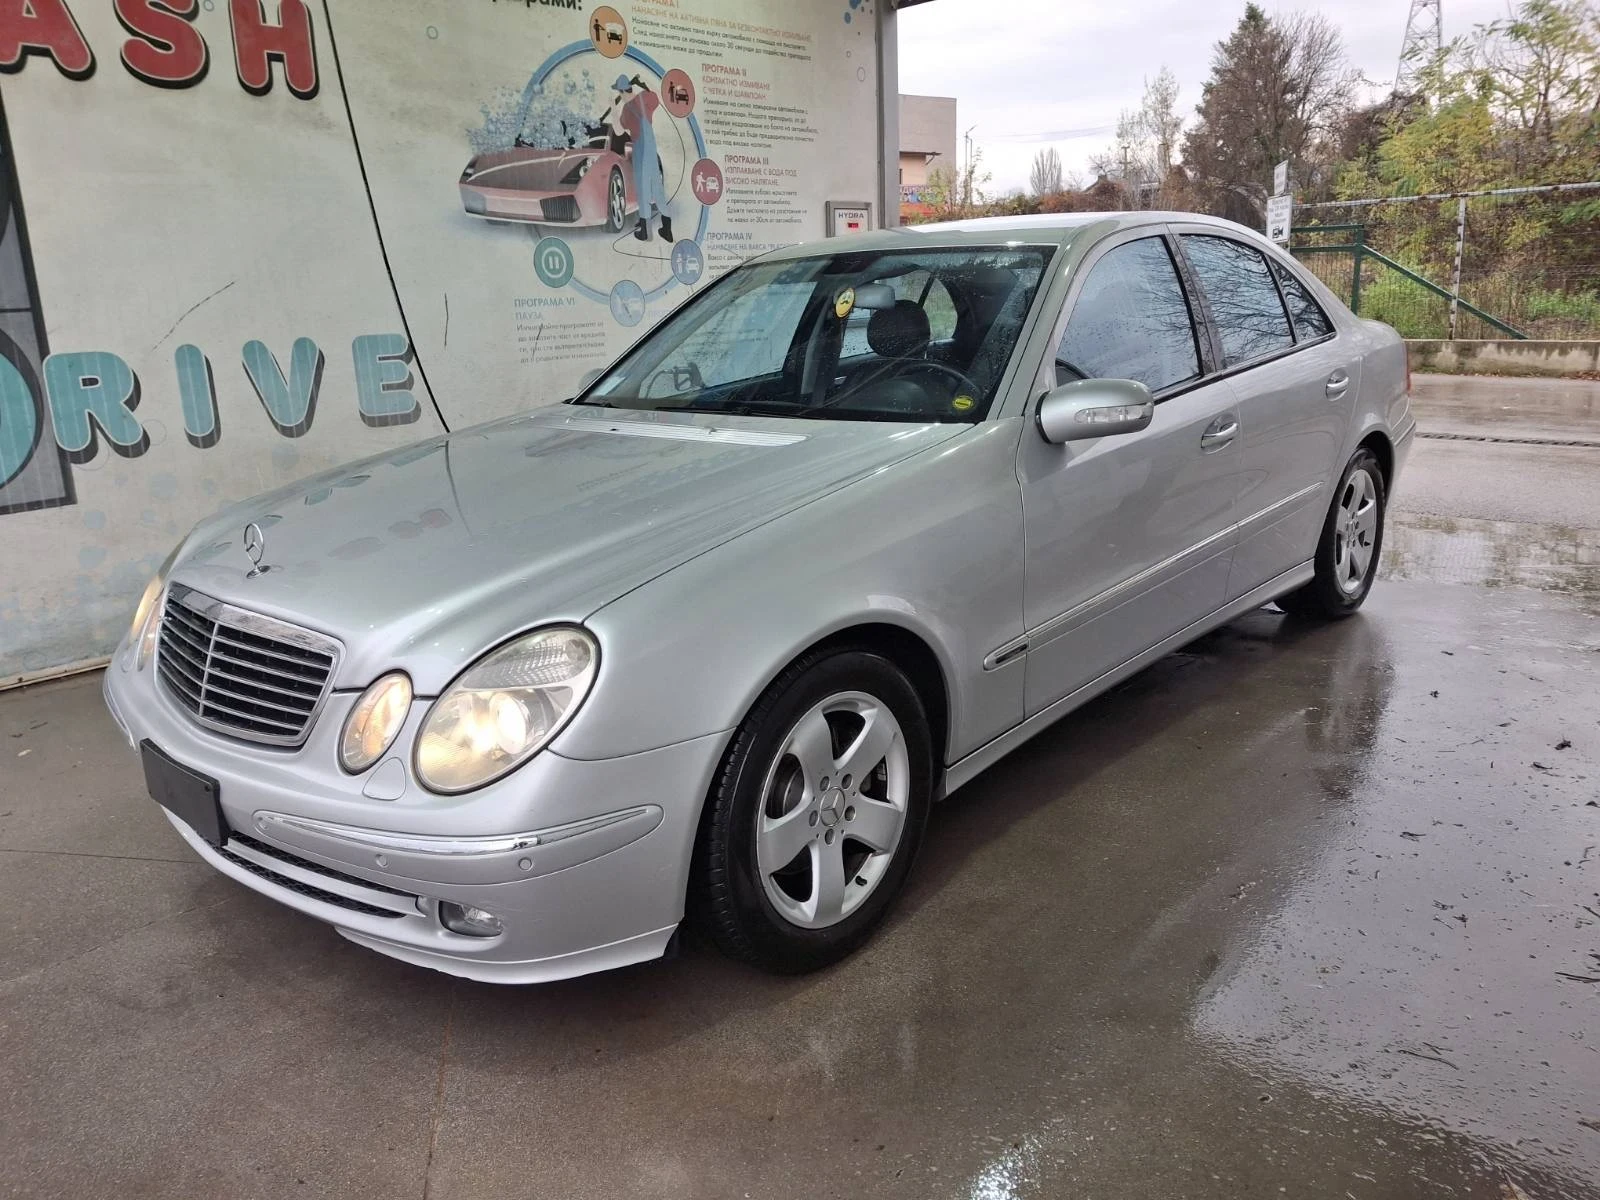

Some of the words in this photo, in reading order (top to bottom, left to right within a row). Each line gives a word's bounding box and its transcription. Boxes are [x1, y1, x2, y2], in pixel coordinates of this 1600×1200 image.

[701, 64, 741, 76] ПРОГРАМА
[702, 75, 738, 87] КОНТАКТНО
[724, 155, 762, 164] ПРОГРАМА
[724, 167, 762, 175] ИЗПЛАКВАНЕ
[706, 232, 744, 240] ПРОГРАМА
[514, 297, 564, 308] ПРОГРАМА
[515, 311, 544, 321] ПАУЗА
